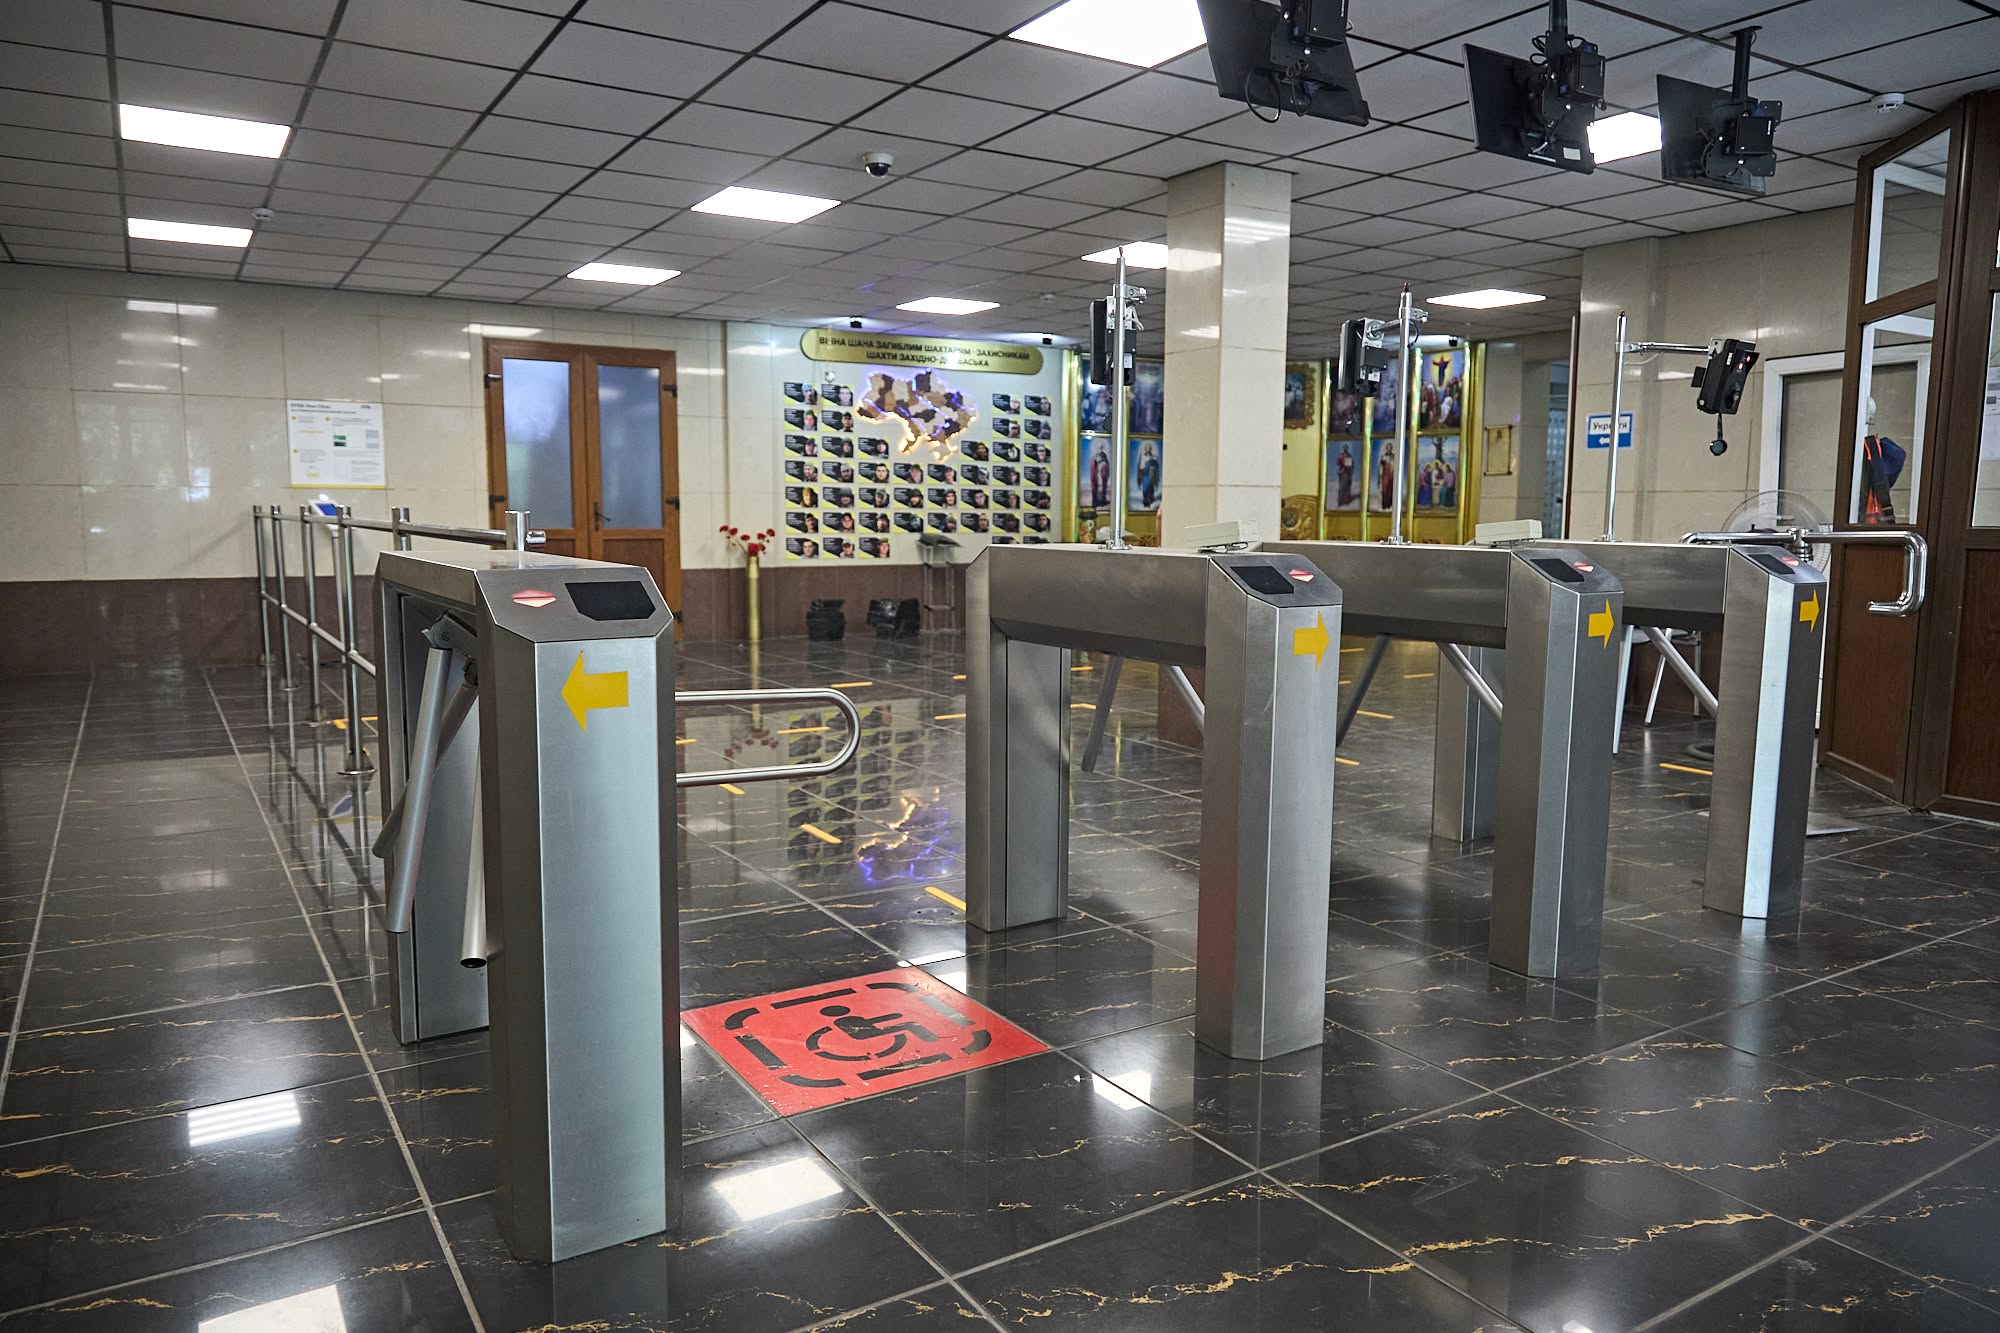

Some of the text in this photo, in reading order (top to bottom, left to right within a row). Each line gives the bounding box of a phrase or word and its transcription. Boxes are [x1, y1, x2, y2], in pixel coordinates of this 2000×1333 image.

[848, 339, 874, 348] ШАНА
[976, 348, 1030, 360] ЗАХИСНИКАМ
[866, 350, 897, 360] ШАХТИ
